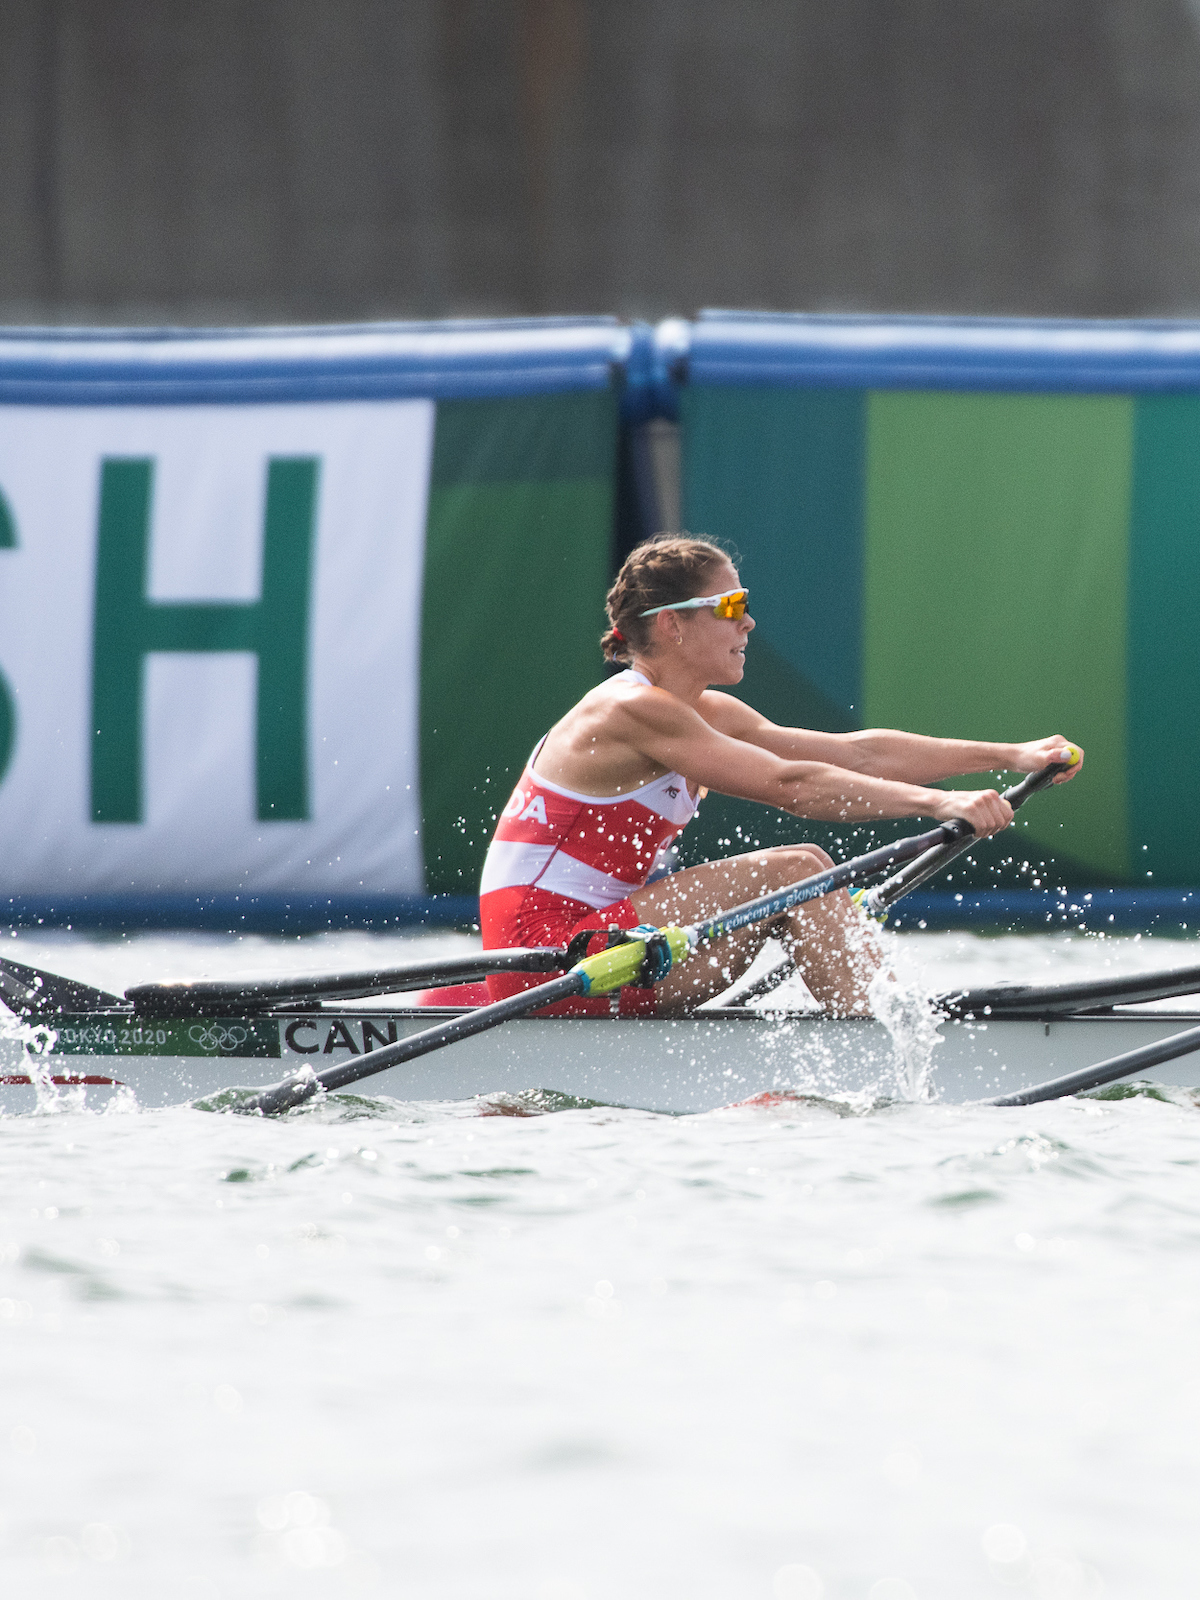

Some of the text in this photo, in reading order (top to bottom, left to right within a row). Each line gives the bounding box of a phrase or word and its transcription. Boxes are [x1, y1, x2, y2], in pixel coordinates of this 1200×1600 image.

[0, 454, 323, 825] H
[53, 1028, 167, 1045] TOKYO 2020
[284, 1020, 399, 1055] CAN
